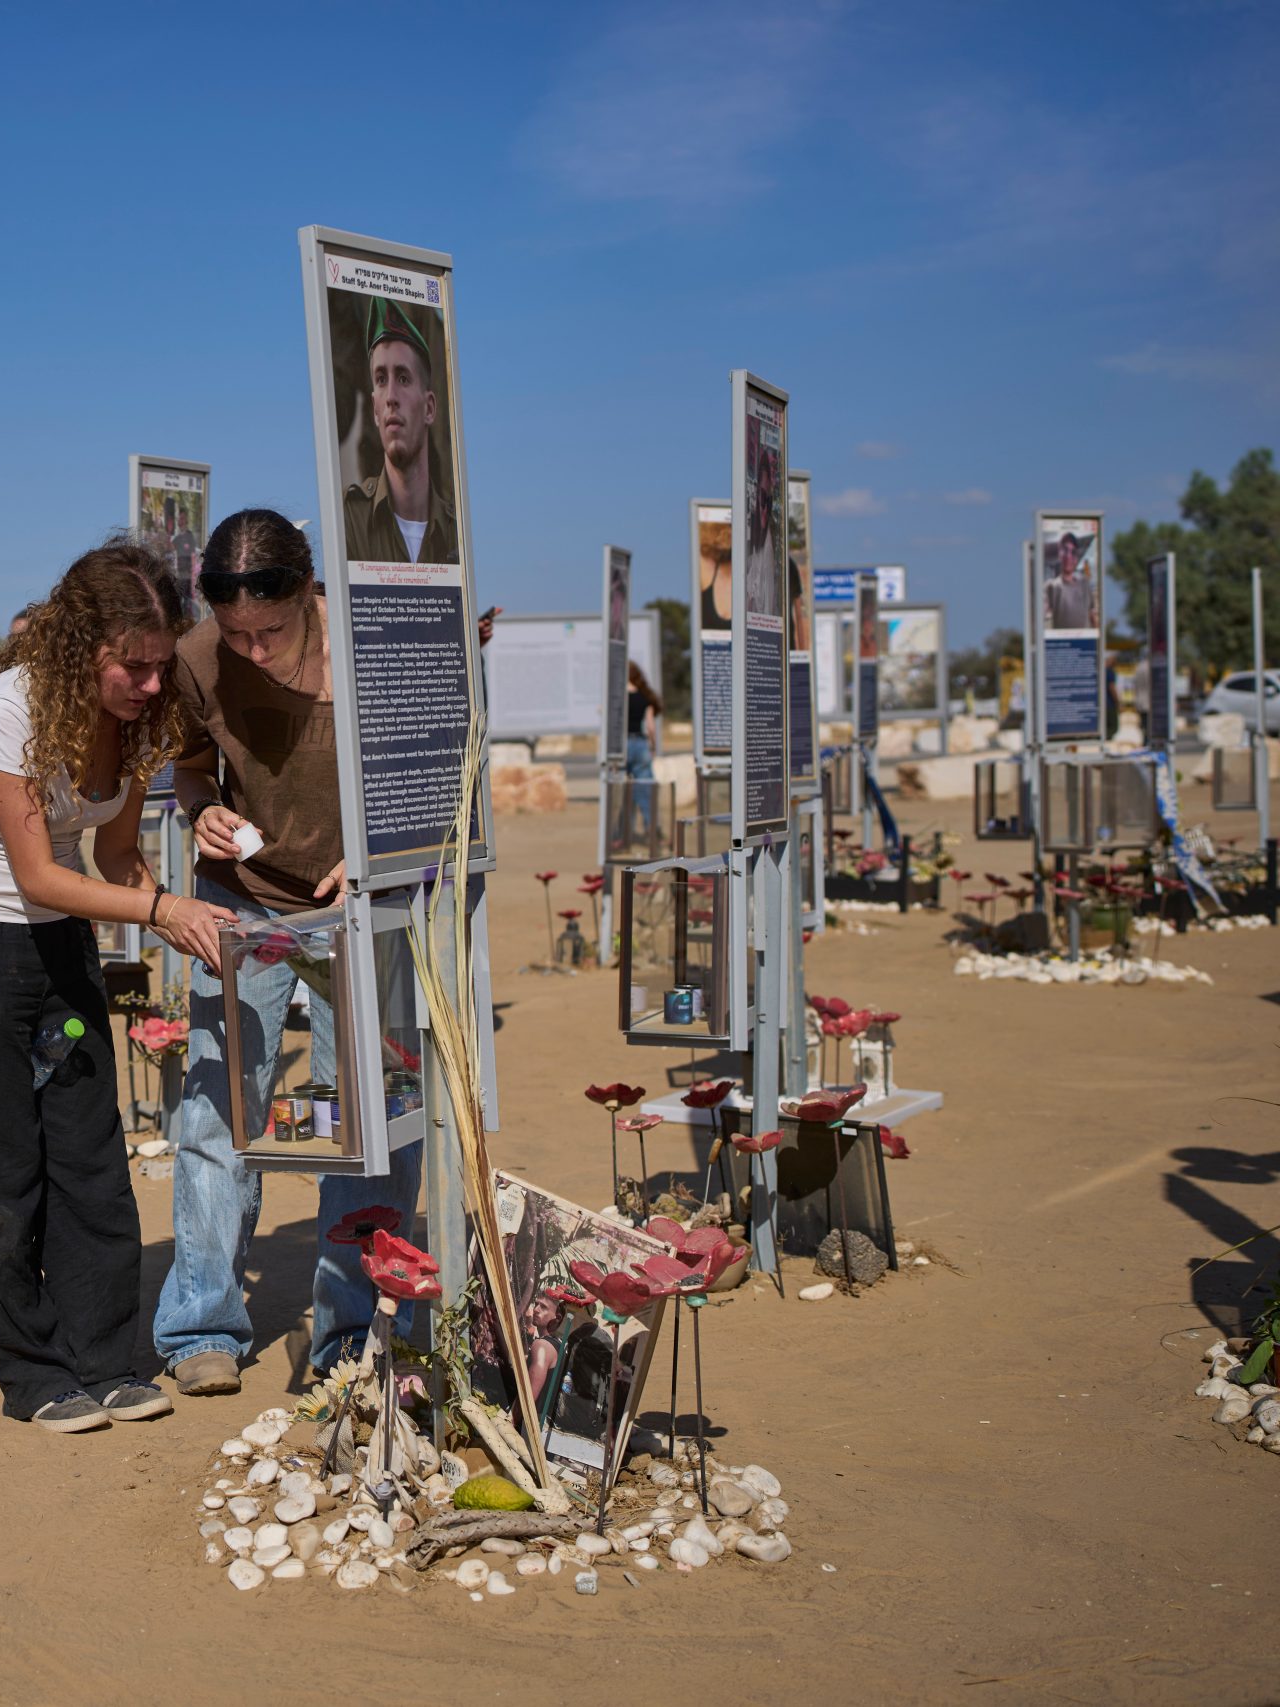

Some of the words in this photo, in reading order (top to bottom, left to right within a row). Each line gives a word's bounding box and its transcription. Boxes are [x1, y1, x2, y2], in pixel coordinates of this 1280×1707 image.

[342, 275, 355, 285] Staff
[357, 279, 368, 289] Sgt.
[369, 282, 382, 290] Aner
[383, 284, 404, 295] Elyakim
[405, 289, 424, 299] Shapiro
